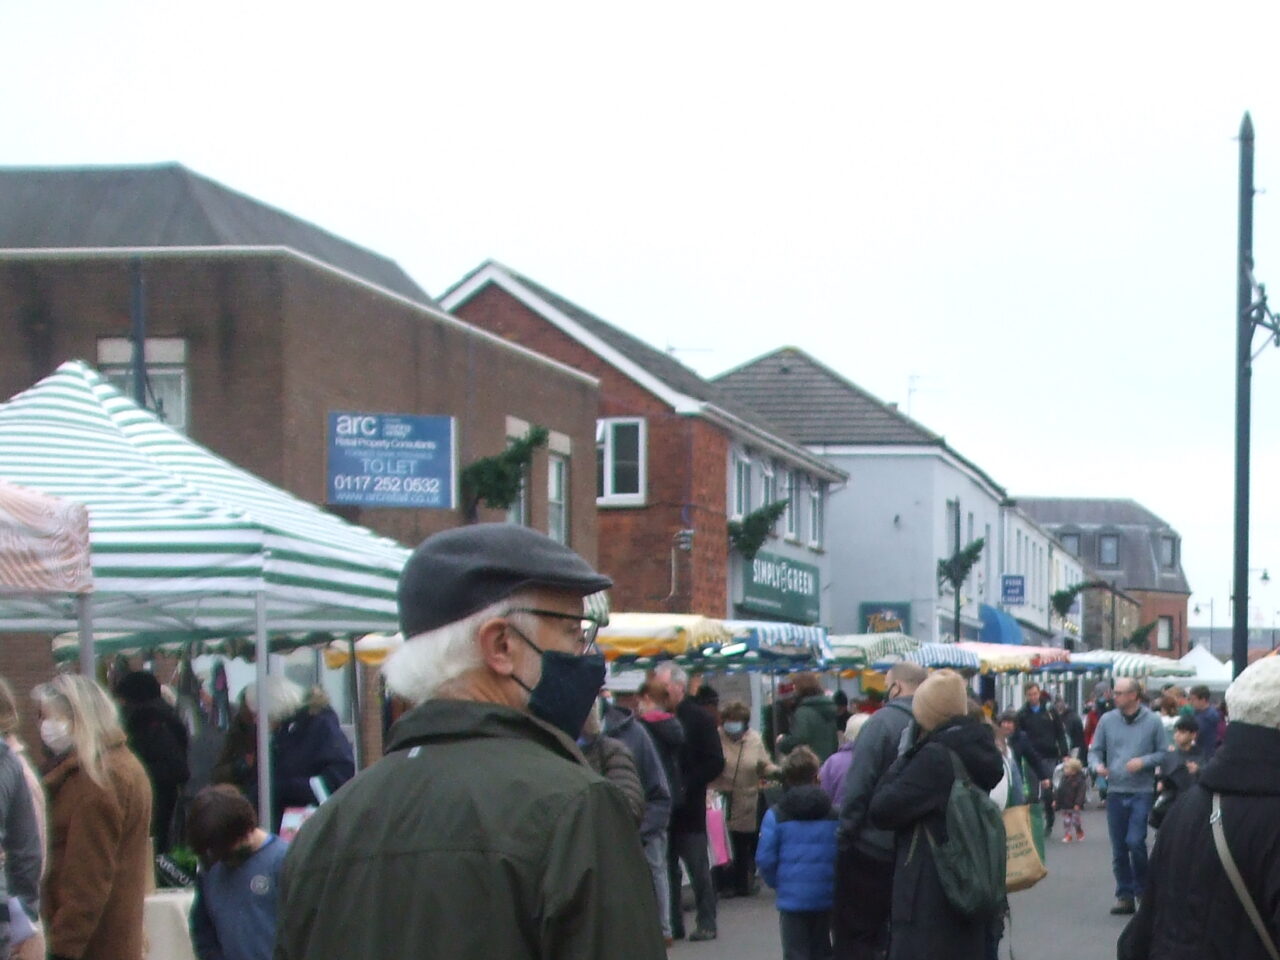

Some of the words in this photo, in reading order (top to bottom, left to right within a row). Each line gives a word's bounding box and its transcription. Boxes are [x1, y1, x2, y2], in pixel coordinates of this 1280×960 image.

[336, 415, 376, 435] arc
[335, 437, 357, 447] Retail
[359, 438, 391, 449] Property
[391, 440, 436, 449] Consultants
[362, 459, 383, 473] TO
[387, 460, 417, 474] LET
[334, 475, 371, 490] 0117
[374, 477, 401, 492] 252
[403, 478, 440, 493] 0532
[753, 559, 780, 589] SIMPLY
[787, 567, 813, 595] GREEN
